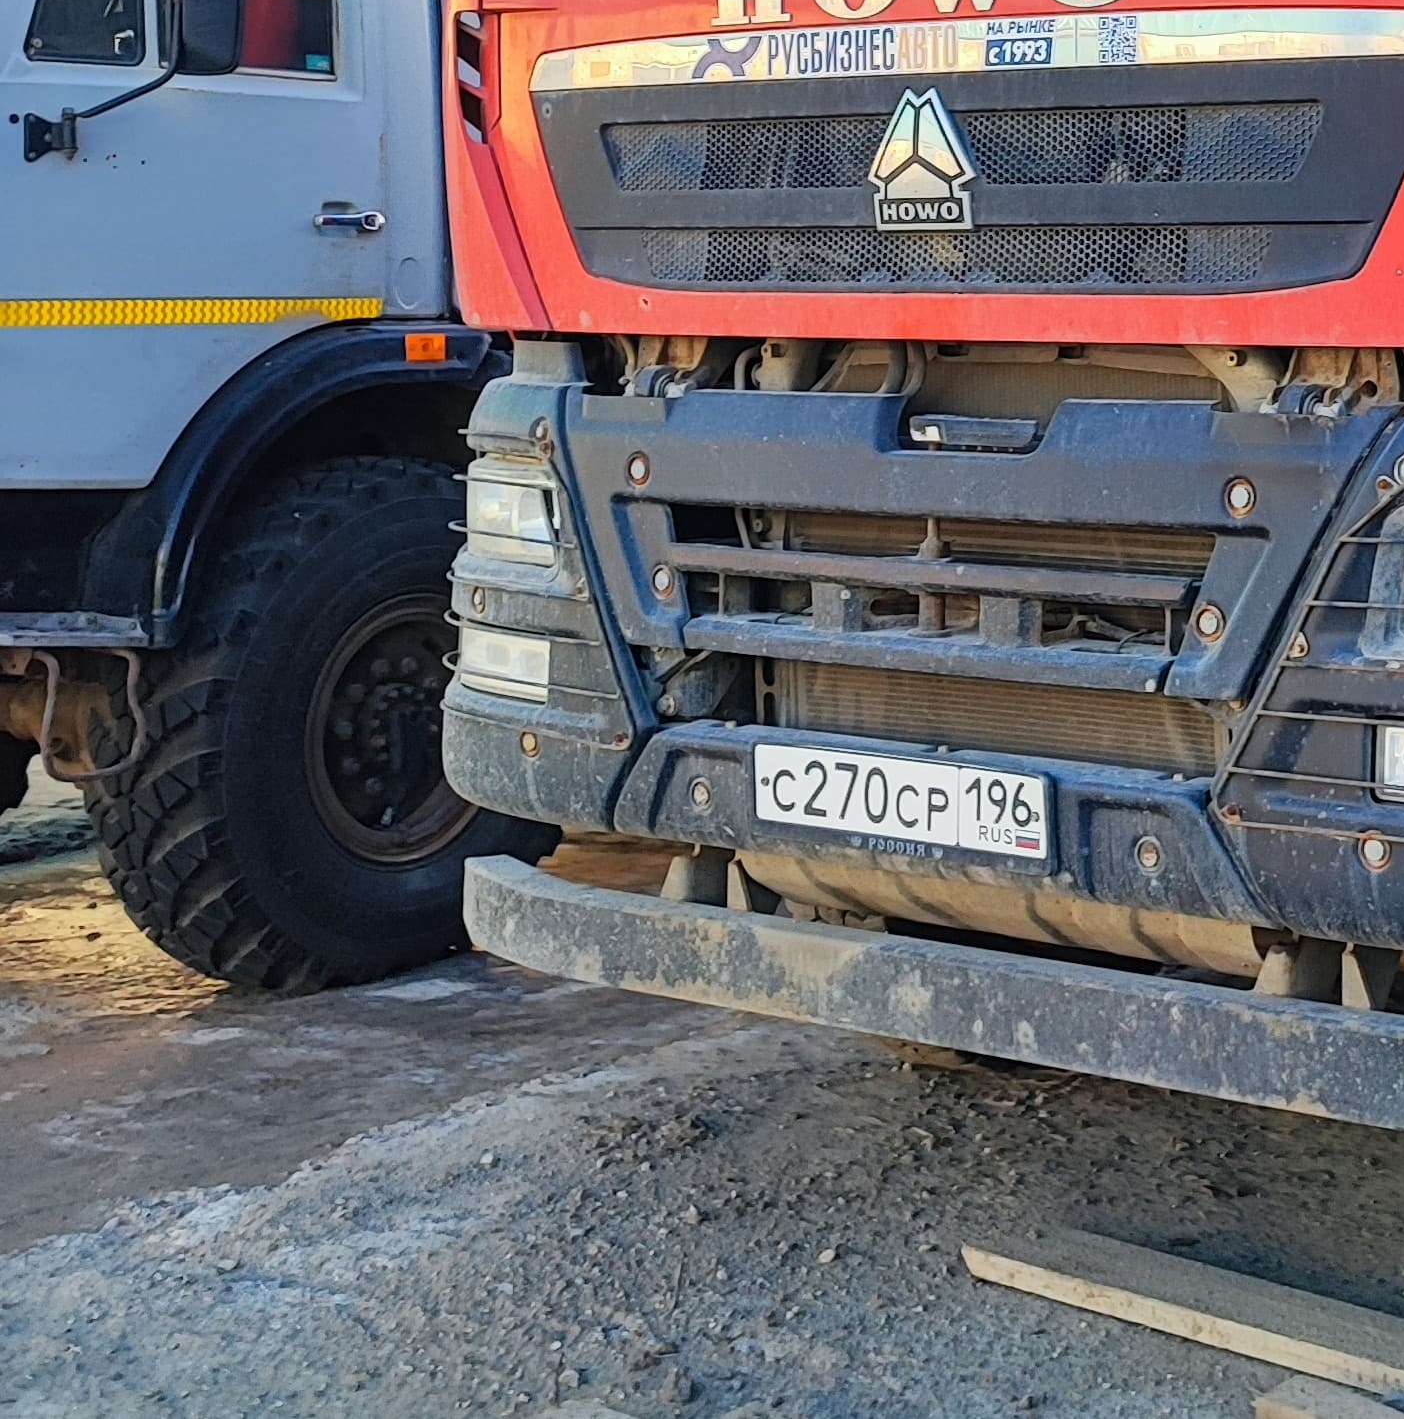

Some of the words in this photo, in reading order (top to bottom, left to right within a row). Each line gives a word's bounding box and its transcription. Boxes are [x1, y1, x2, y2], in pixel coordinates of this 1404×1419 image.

[986, 21, 1003, 35] НА
[1007, 18, 1056, 34] РЫНКЕ
[767, 23, 959, 76] РУСБИЗНЕСАВТО
[881, 201, 960, 221] HOWO
[771, 759, 950, 832] С270СР
[965, 776, 1033, 828] 196
[977, 825, 1014, 846] RUS
